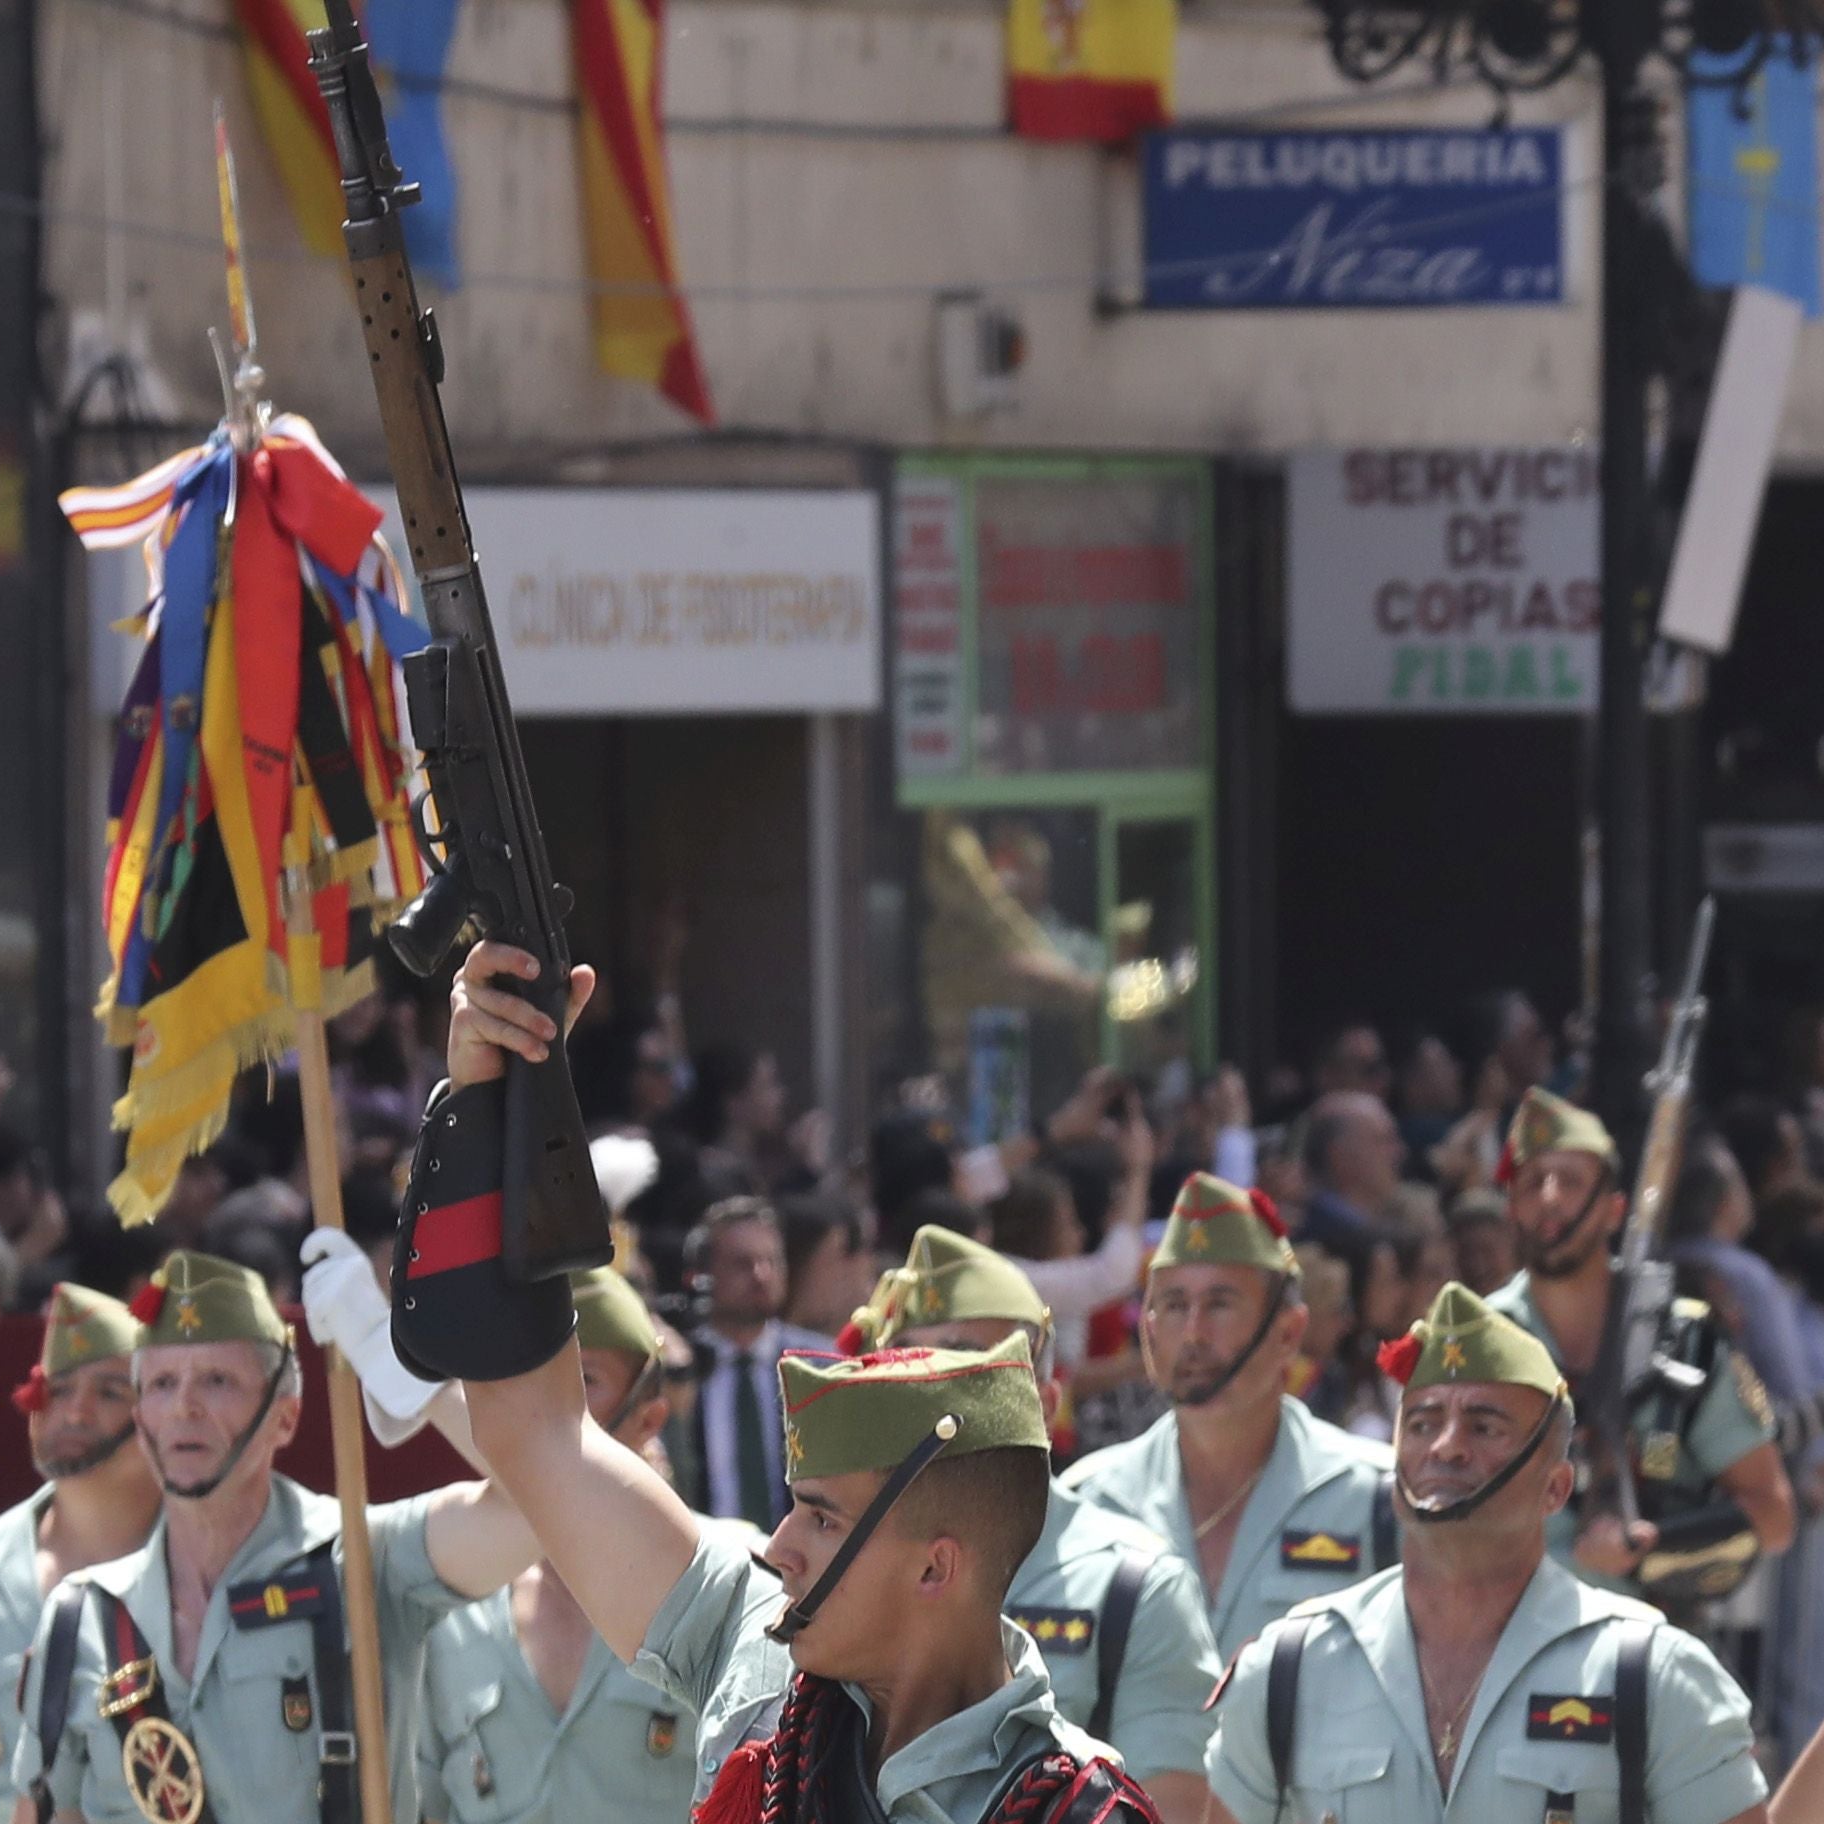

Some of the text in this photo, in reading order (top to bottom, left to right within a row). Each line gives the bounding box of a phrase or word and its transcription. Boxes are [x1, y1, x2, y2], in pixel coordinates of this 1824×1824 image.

[1204, 198, 1486, 297] Niza
[1447, 513, 1523, 569] DE
[633, 570, 675, 647] DE
[1375, 578, 1602, 634] COPIAS
